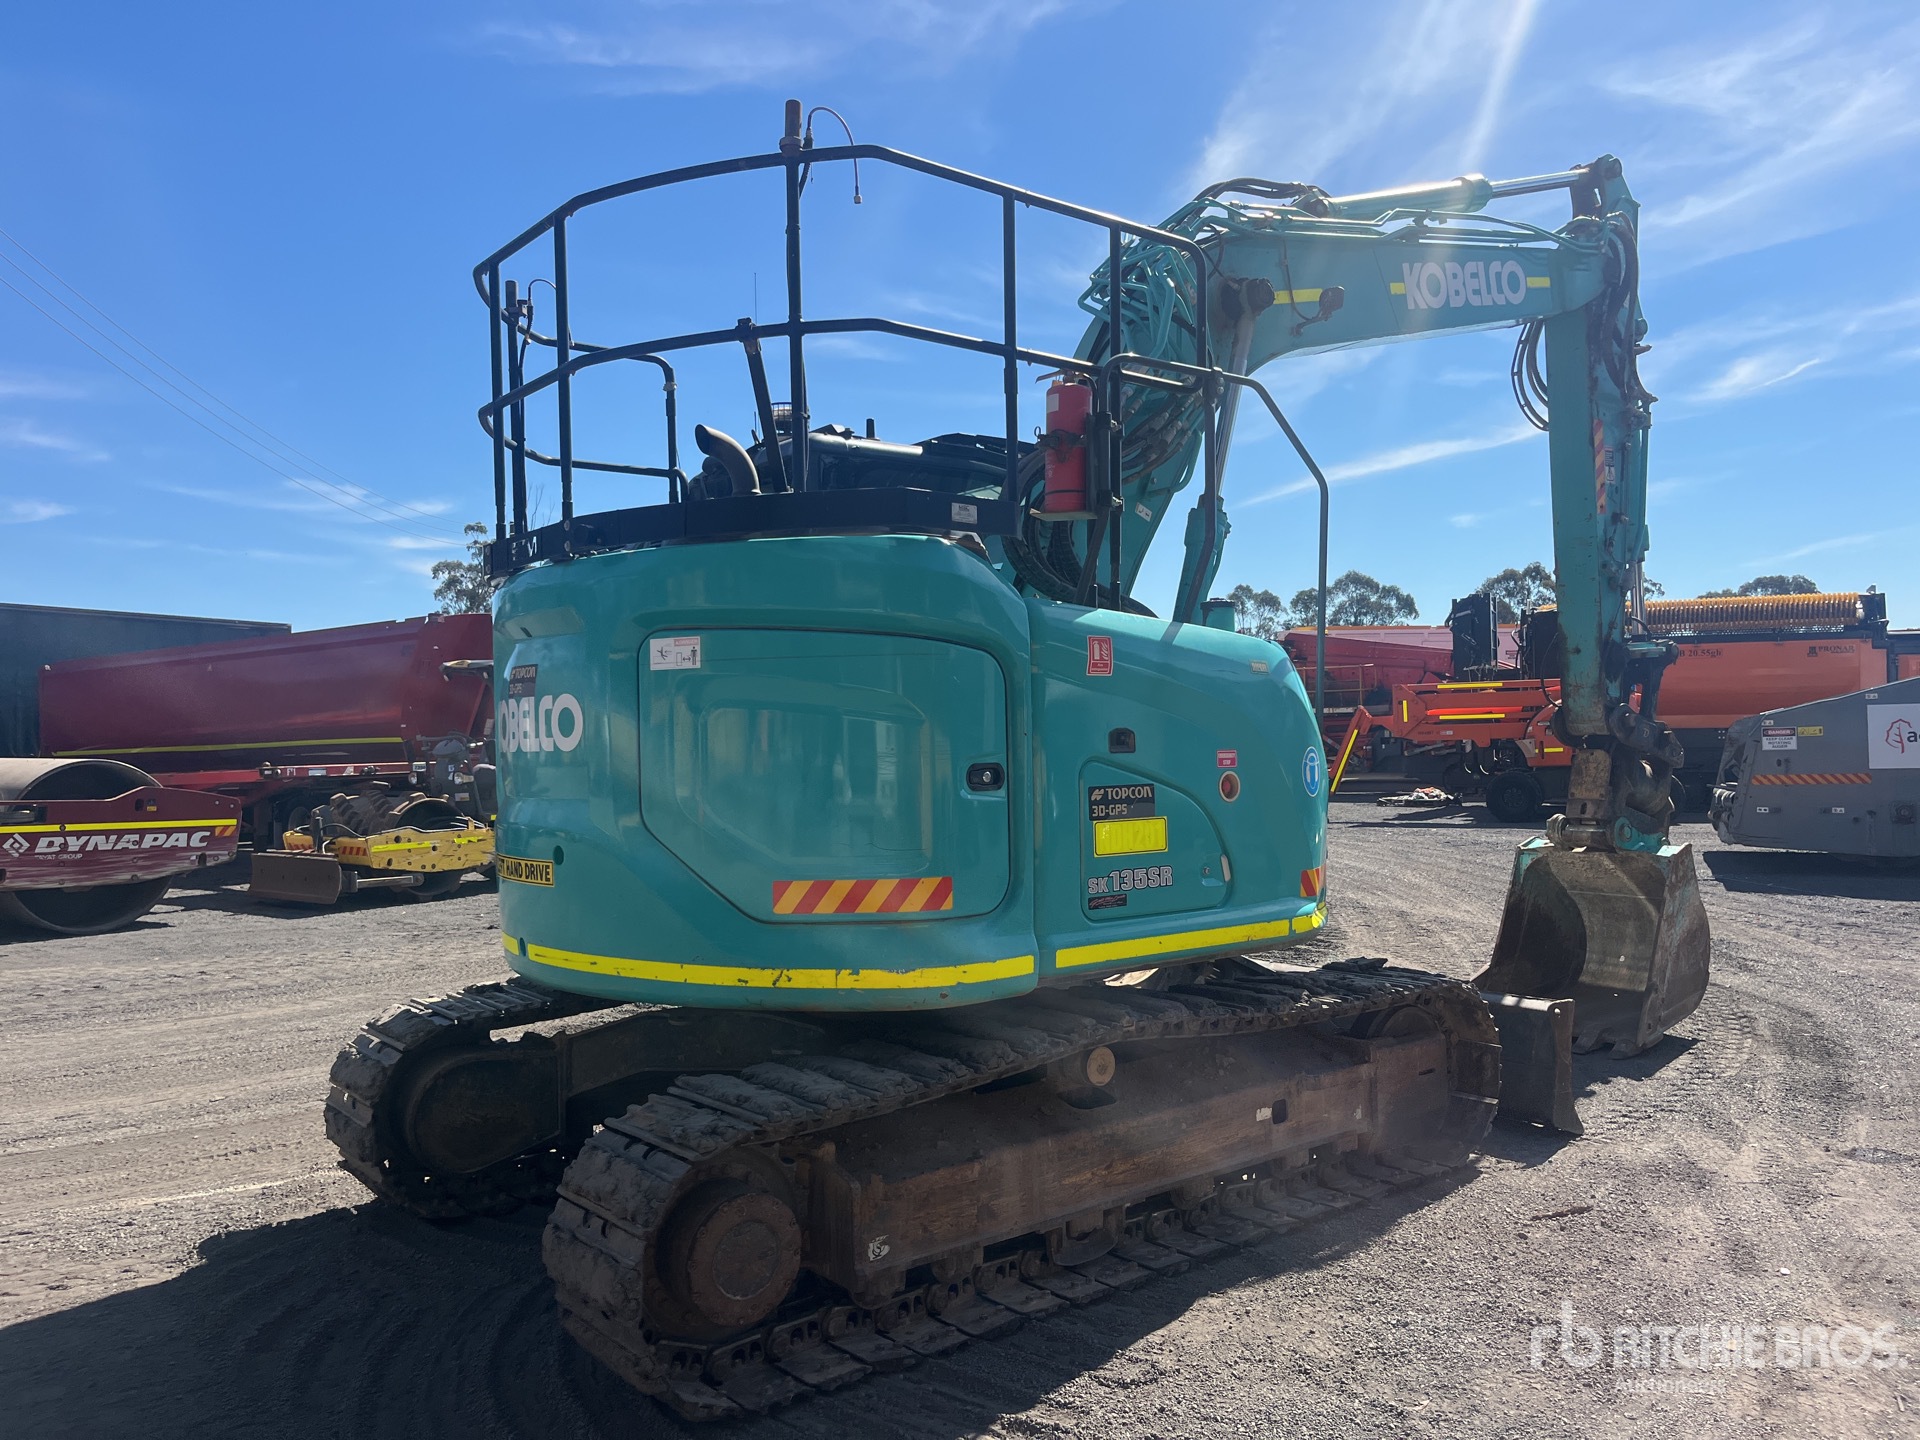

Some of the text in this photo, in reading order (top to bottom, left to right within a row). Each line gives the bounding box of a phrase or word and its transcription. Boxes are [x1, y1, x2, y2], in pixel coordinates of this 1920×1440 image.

[1402, 260, 1527, 310] KOBELCO
[498, 693, 583, 752] OBELCO
[1907, 730, 1920, 743] a
[1105, 786, 1153, 800] TOPCON
[1092, 804, 1128, 817] 3D-GPS
[34, 831, 211, 854] DYNAPAC
[525, 862, 551, 882] DRIVE
[1088, 866, 1173, 894] SK135SR
